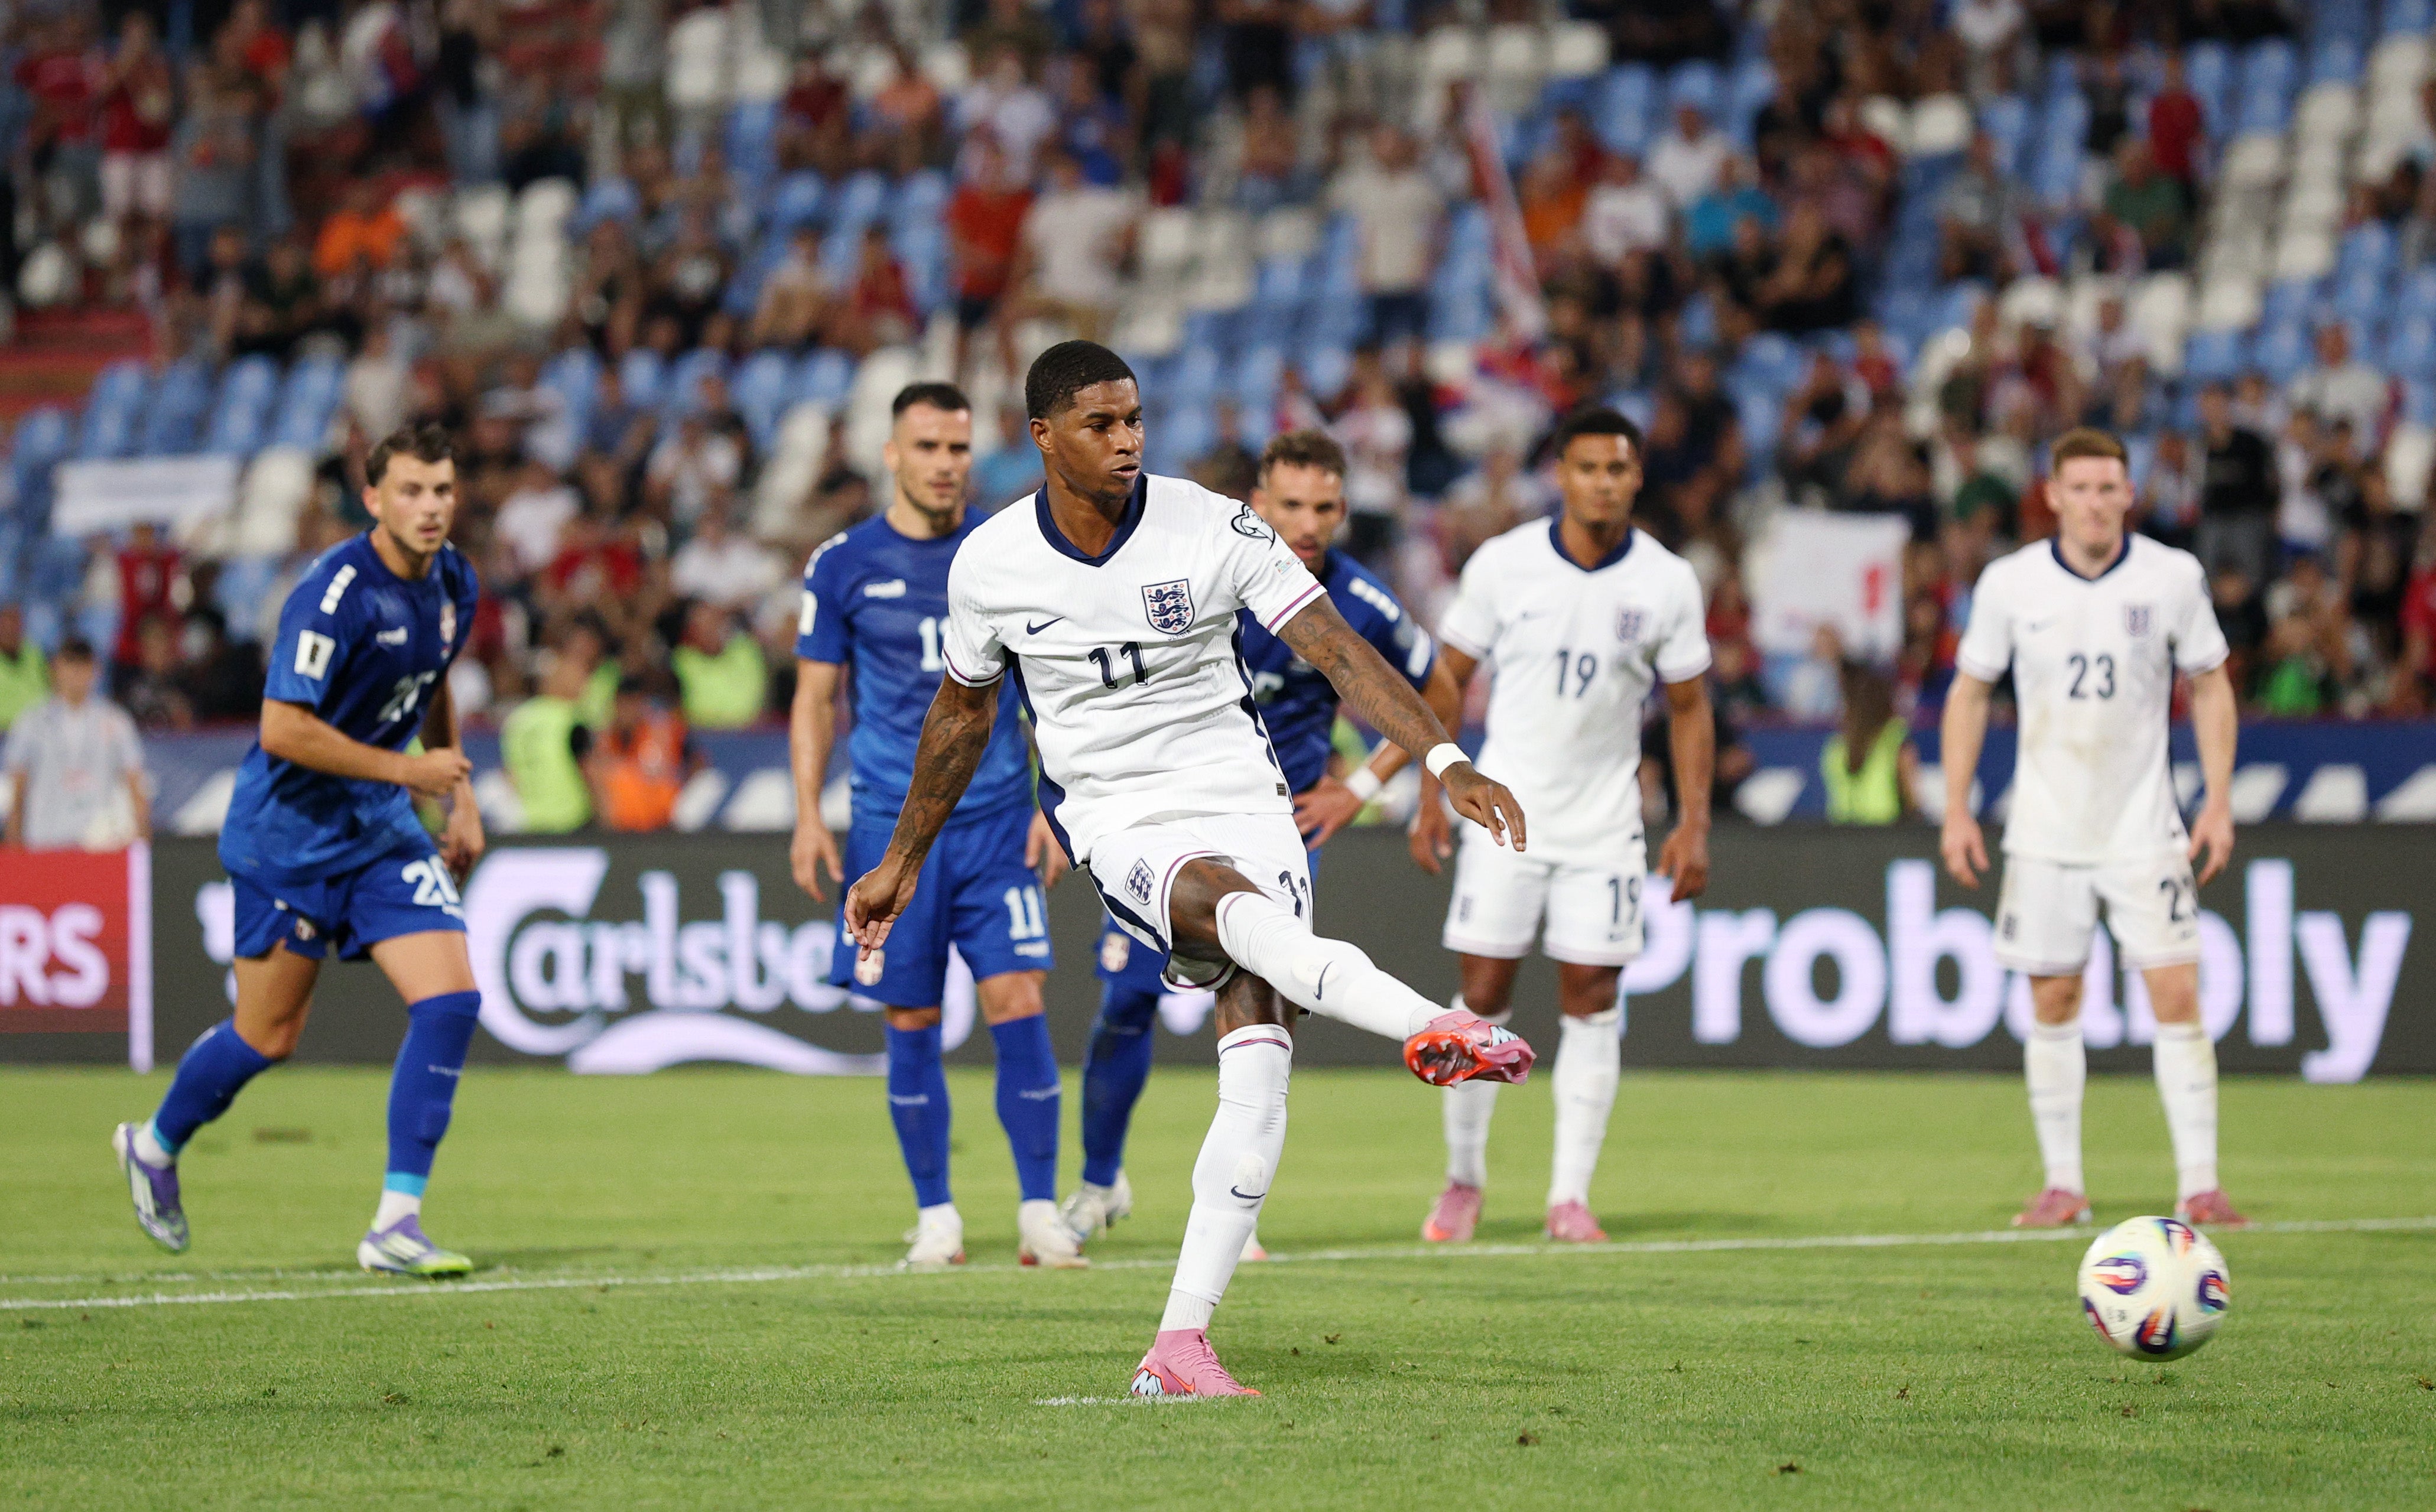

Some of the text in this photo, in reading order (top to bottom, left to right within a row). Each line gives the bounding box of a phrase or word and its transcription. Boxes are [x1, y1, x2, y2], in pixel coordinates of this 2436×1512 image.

[1088, 642, 1148, 689] 11
[1557, 650, 1596, 698] 19
[2069, 654, 2116, 700] 23
[1003, 886, 1045, 940] 11
[1608, 877, 1641, 924] 19
[464, 847, 976, 1055] Carlsbe
